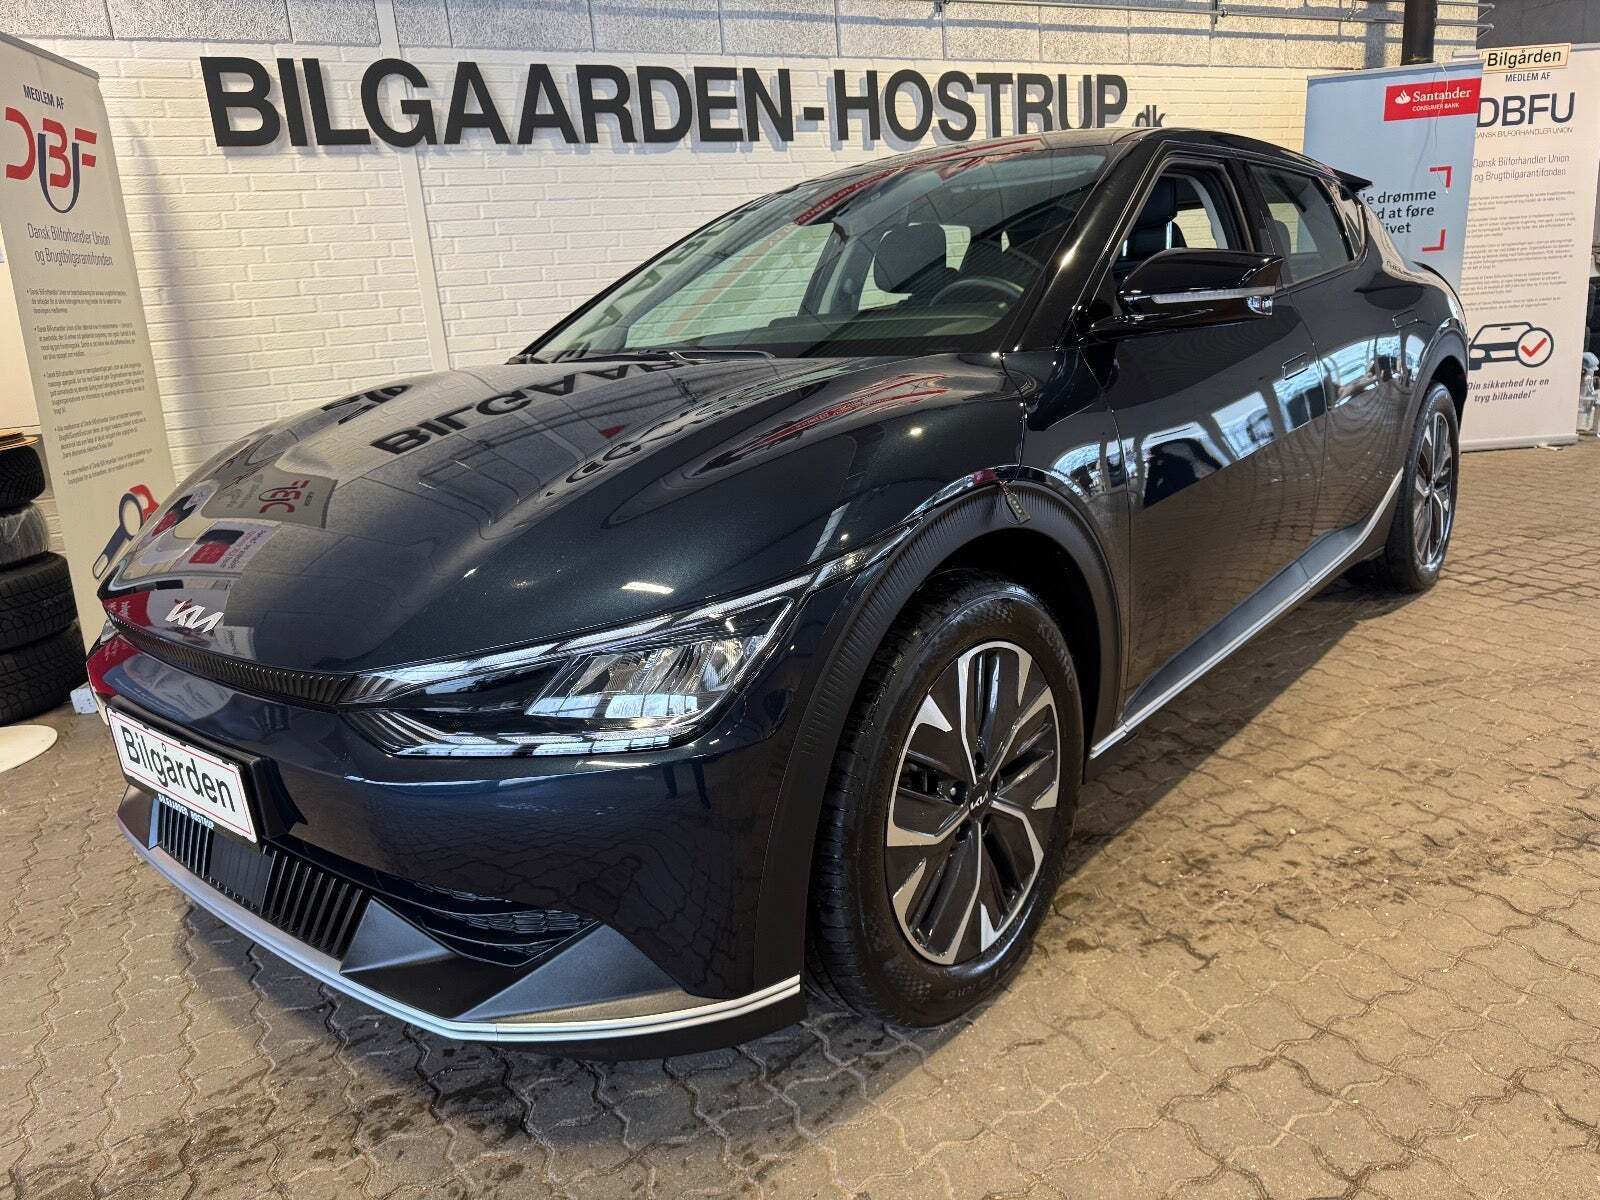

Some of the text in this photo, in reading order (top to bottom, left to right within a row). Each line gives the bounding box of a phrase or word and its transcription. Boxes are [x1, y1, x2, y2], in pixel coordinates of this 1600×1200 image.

[1487, 49, 1561, 69] Bilgården
[1505, 72, 1551, 83] MEDLEM AF
[23, 84, 64, 110] MEDLEM AF
[1412, 86, 1472, 102] Santander
[1411, 103, 1443, 112] CONSUMER
[1476, 92, 1576, 128] DBFU
[1497, 127, 1552, 138] BILFORHANDLER
[1552, 126, 1574, 135] UNION
[1498, 154, 1547, 167] Bilforhandler
[1548, 154, 1570, 164] Union
[1474, 173, 1485, 184] og
[1378, 190, 1436, 204] drømme
[1389, 207, 1402, 219] at
[1406, 205, 1434, 218] føre
[27, 222, 112, 246] Dansk Bilforhandler Union
[34, 250, 45, 266] og
[1483, 378, 1525, 390] sikkerhed
[1526, 377, 1538, 387] for
[1539, 378, 1550, 386] en
[1474, 394, 1490, 406] tryg
[121, 726, 236, 812] Bilgården
